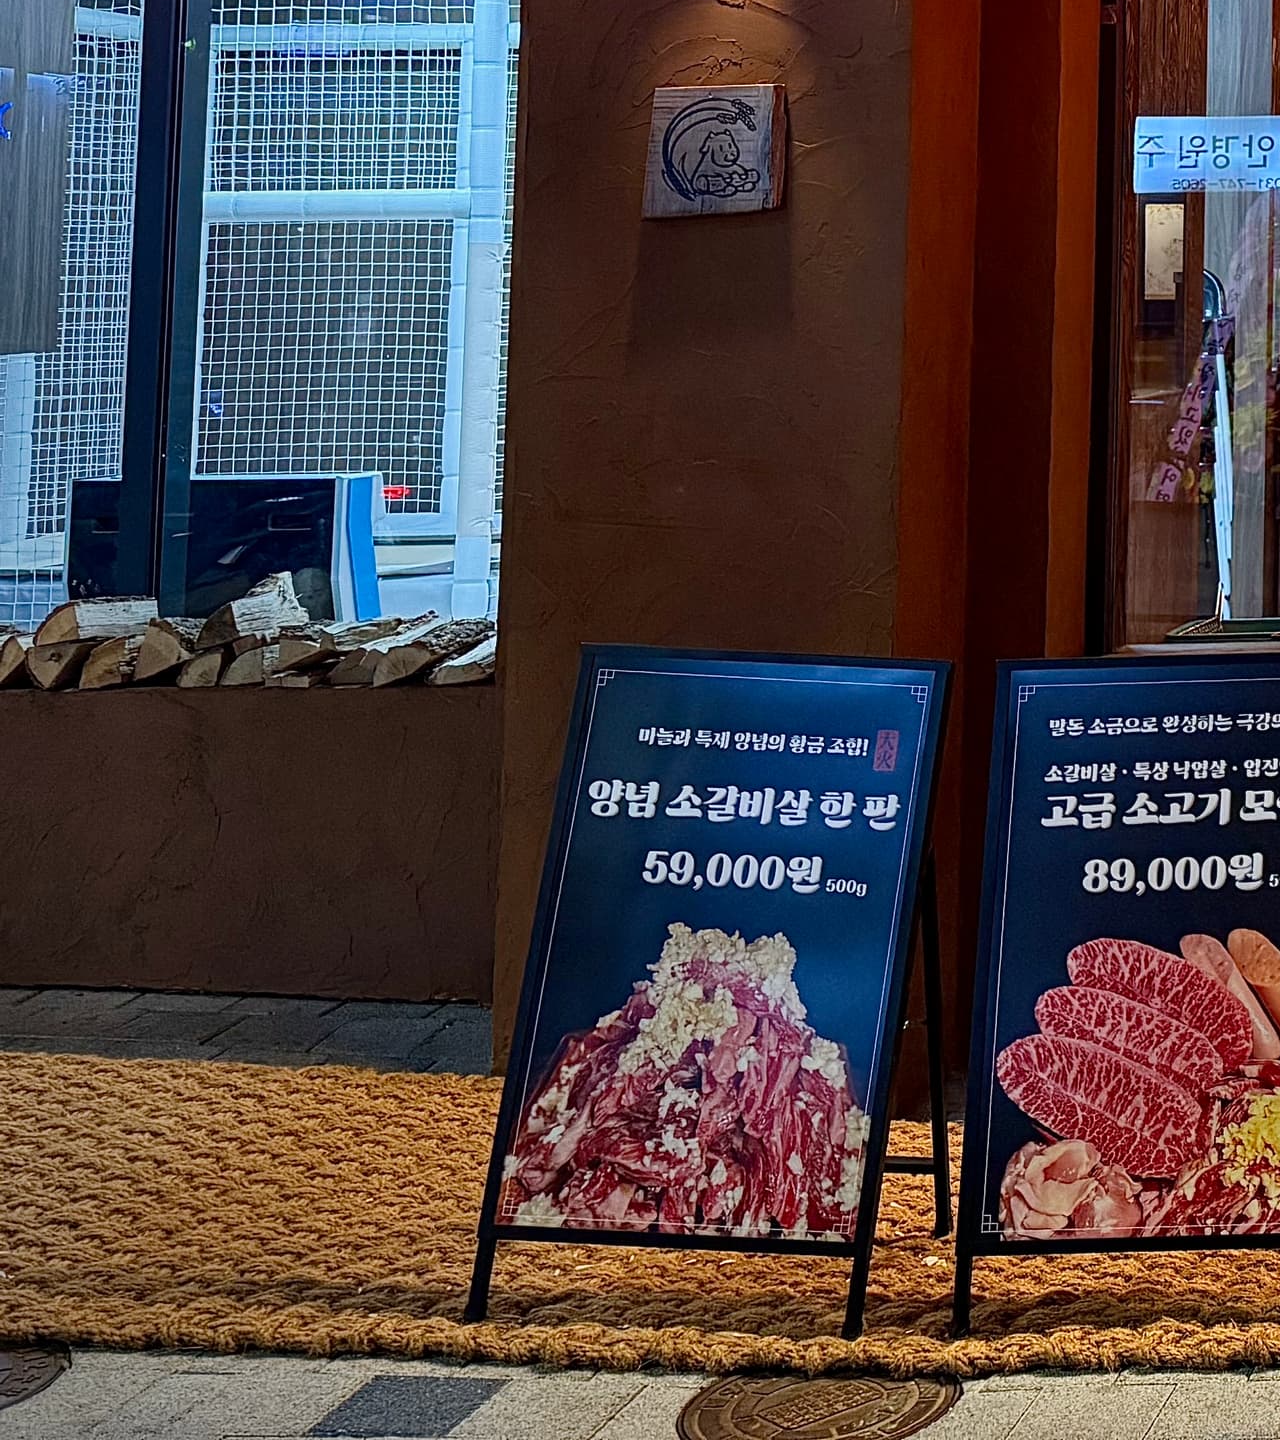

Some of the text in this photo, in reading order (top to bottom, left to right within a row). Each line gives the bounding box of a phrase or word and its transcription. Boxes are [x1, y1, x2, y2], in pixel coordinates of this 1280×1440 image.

[638, 727, 869, 757] 마늘과 특제 양념의 황금 조합!
[1049, 718, 1085, 737] 말돈
[1087, 716, 1159, 735] 소금으로
[1161, 714, 1233, 734] 완성하는
[588, 778, 901, 831] 양념 소갈비살 한 판
[1040, 791, 1117, 830] 고급
[1122, 787, 1232, 827] 소고기
[641, 850, 868, 898] 59,000원 500g
[1081, 852, 1264, 896] 89,000원
